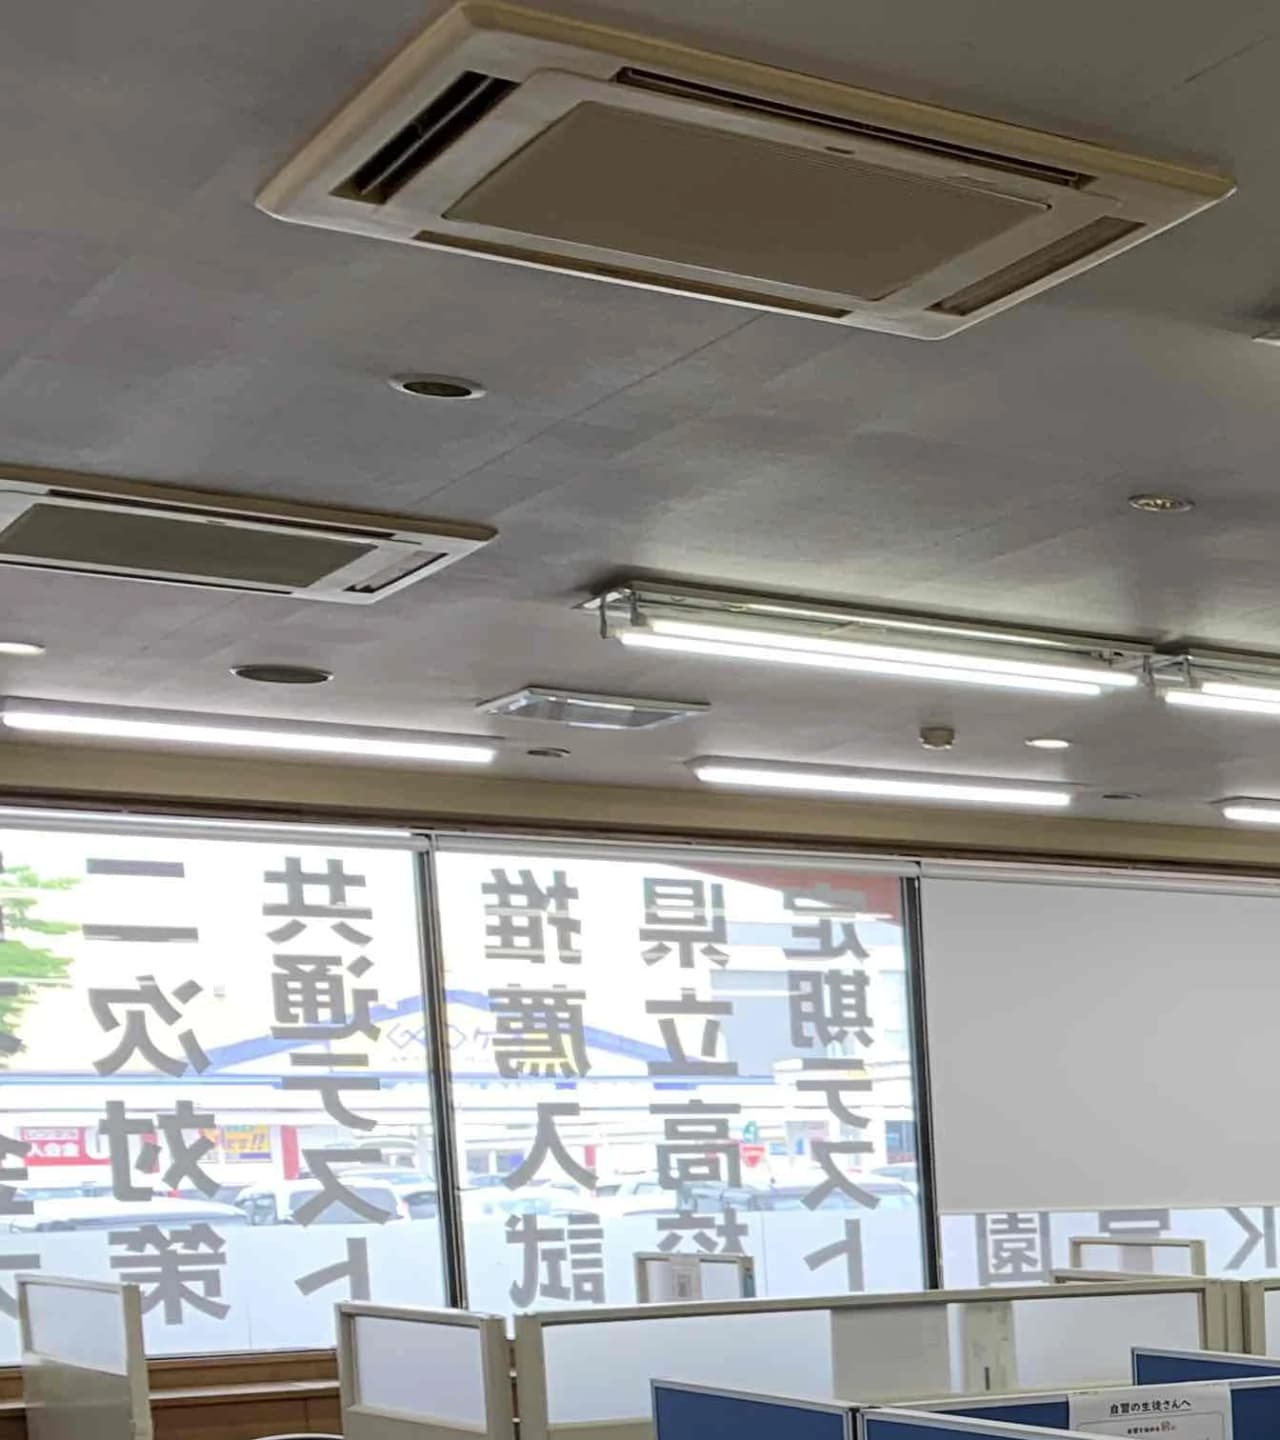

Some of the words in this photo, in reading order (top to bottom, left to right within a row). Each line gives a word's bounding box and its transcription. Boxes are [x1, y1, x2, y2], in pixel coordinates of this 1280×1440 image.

[1110, 1400, 1191, 1415] 自習の生徒さんへ
